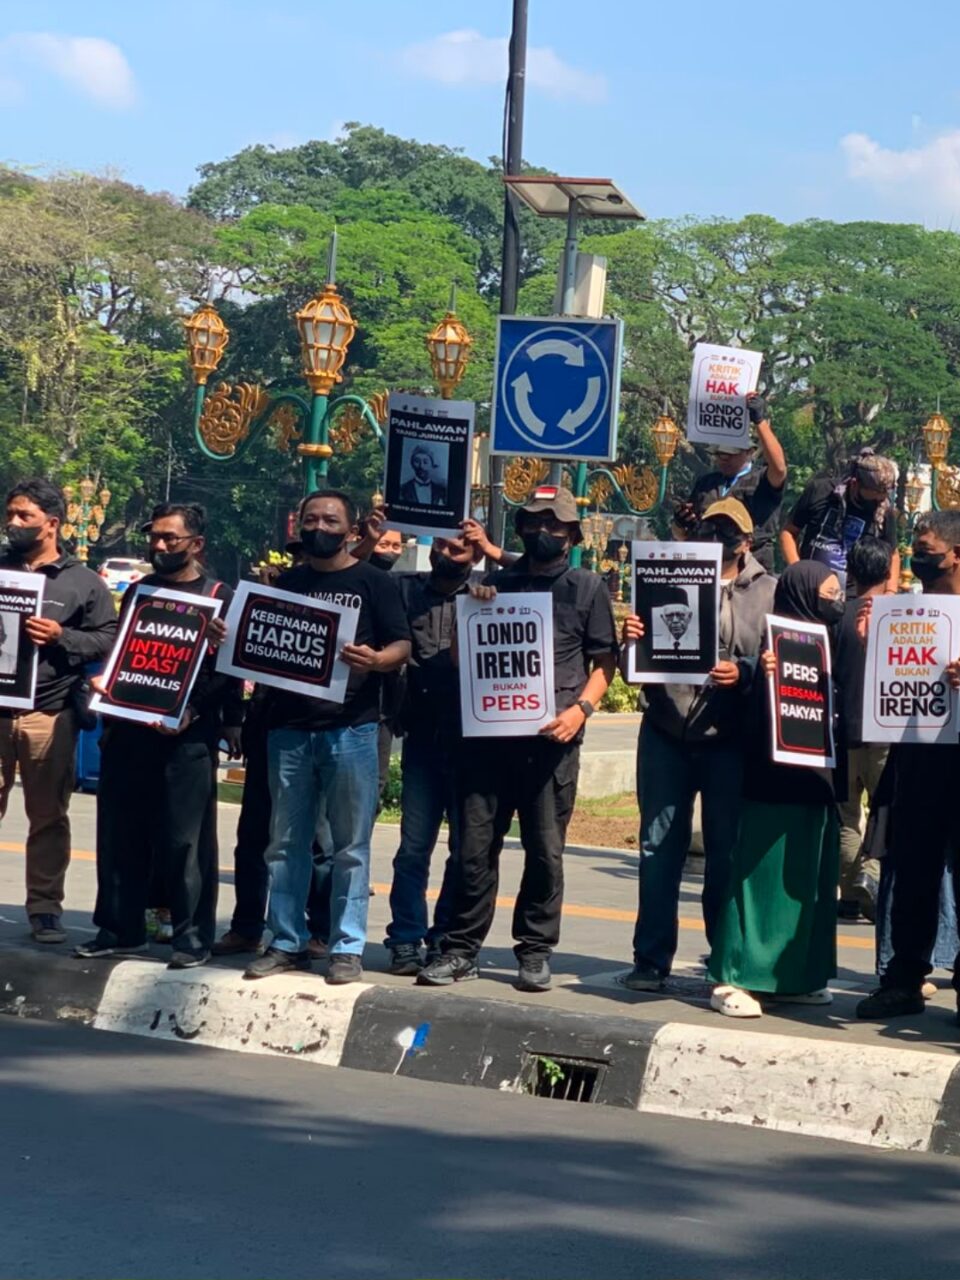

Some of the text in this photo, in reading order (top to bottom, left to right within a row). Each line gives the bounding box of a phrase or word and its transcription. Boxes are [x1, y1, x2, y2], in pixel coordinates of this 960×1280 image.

[705, 380, 740, 395] HAK
[699, 402, 744, 417] LONDO
[391, 417, 467, 434] PAHLAWAN
[699, 414, 743, 430] IRENG
[637, 567, 715, 576] PAHLAWAN
[0, 594, 37, 605] AWAN
[135, 620, 199, 642] LAWAN
[250, 608, 328, 636] KEBENARAN
[889, 622, 937, 635] KRITIK
[246, 622, 326, 656] HARUS
[477, 621, 537, 646] LONDO
[892, 636, 933, 644] ADALAH
[129, 638, 192, 661] INTIMI
[245, 642, 323, 669] DISUARAKAN
[888, 646, 938, 666] HAK
[131, 654, 180, 675] DASI
[476, 650, 541, 679] IRENG
[783, 662, 819, 683] PERS
[895, 667, 930, 676] BUKAN
[117, 670, 182, 692] JURNALIS
[492, 682, 527, 691] BUKAN
[880, 681, 946, 697] LONDO
[780, 685, 824, 702] BERSAMA
[482, 694, 540, 712] PERS
[780, 703, 824, 721] RAKYAT
[880, 698, 946, 717] IRENG
